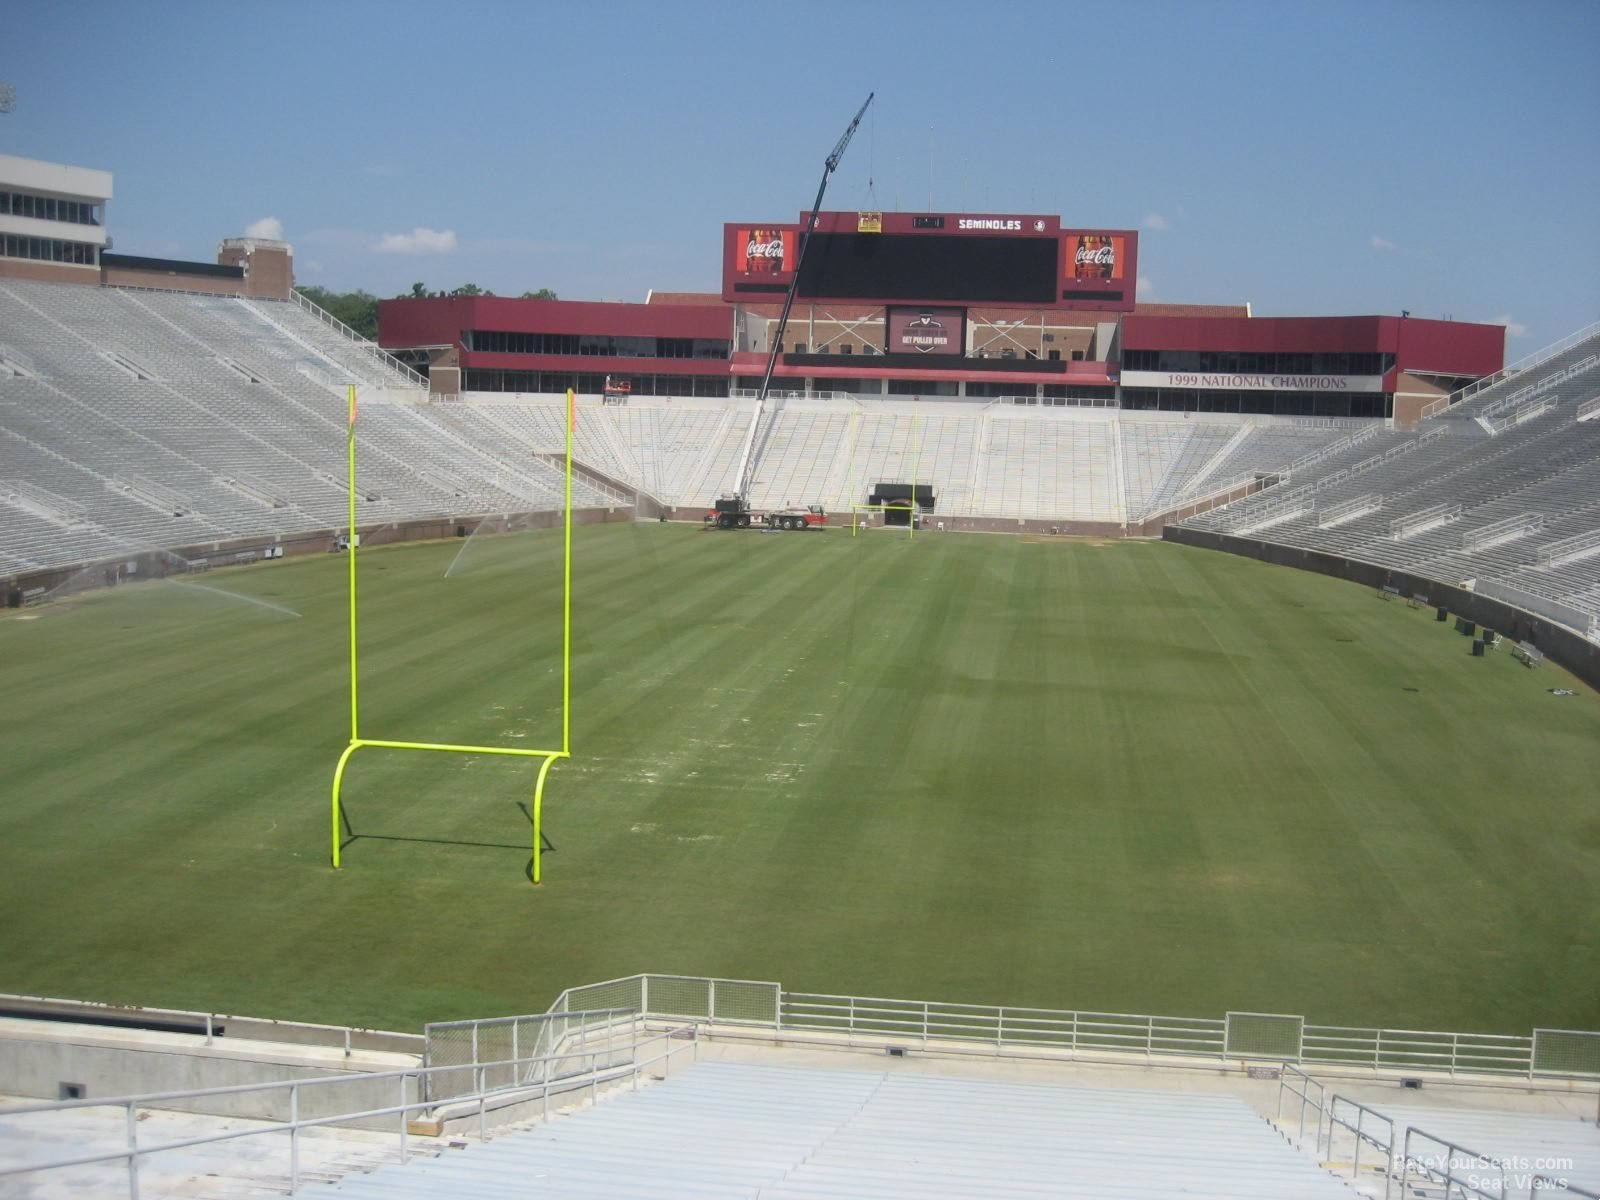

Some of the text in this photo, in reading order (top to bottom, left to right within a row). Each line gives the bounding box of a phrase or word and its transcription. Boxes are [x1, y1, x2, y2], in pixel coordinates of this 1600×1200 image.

[958, 219, 1021, 230] SEMINOLES
[902, 336, 948, 345] GET PULLED OVER
[1168, 374, 1347, 389] 1999 NATIONAL CHAMPIONS
